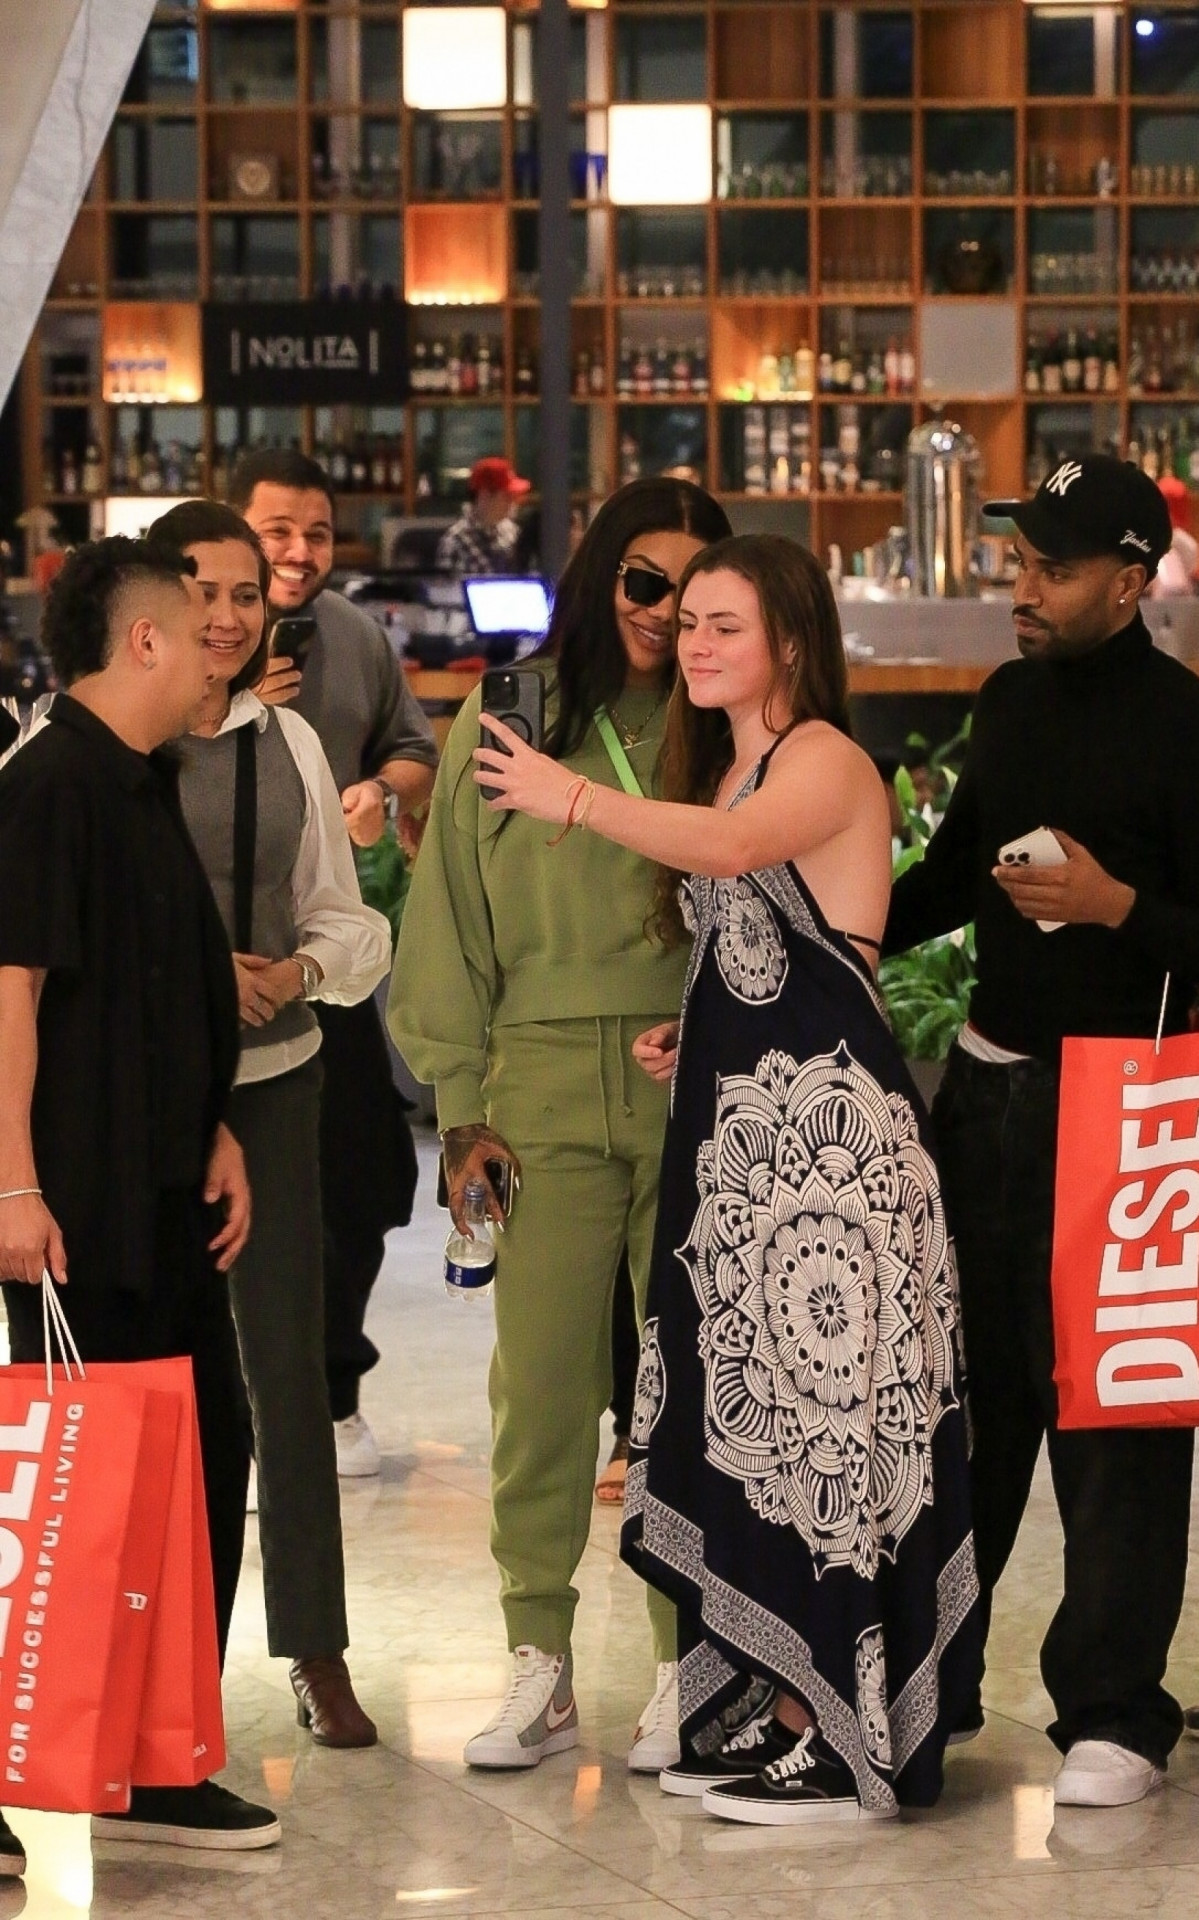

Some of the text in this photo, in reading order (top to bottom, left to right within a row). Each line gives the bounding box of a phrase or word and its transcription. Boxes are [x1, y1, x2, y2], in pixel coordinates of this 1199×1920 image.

[248, 336, 359, 369] NOLITA
[1046, 461, 1082, 496] NY
[50, 1403, 85, 1502] LIVING
[14, 1513, 63, 1711] SUCCESSFUL
[5, 1721, 31, 1783] FOR
